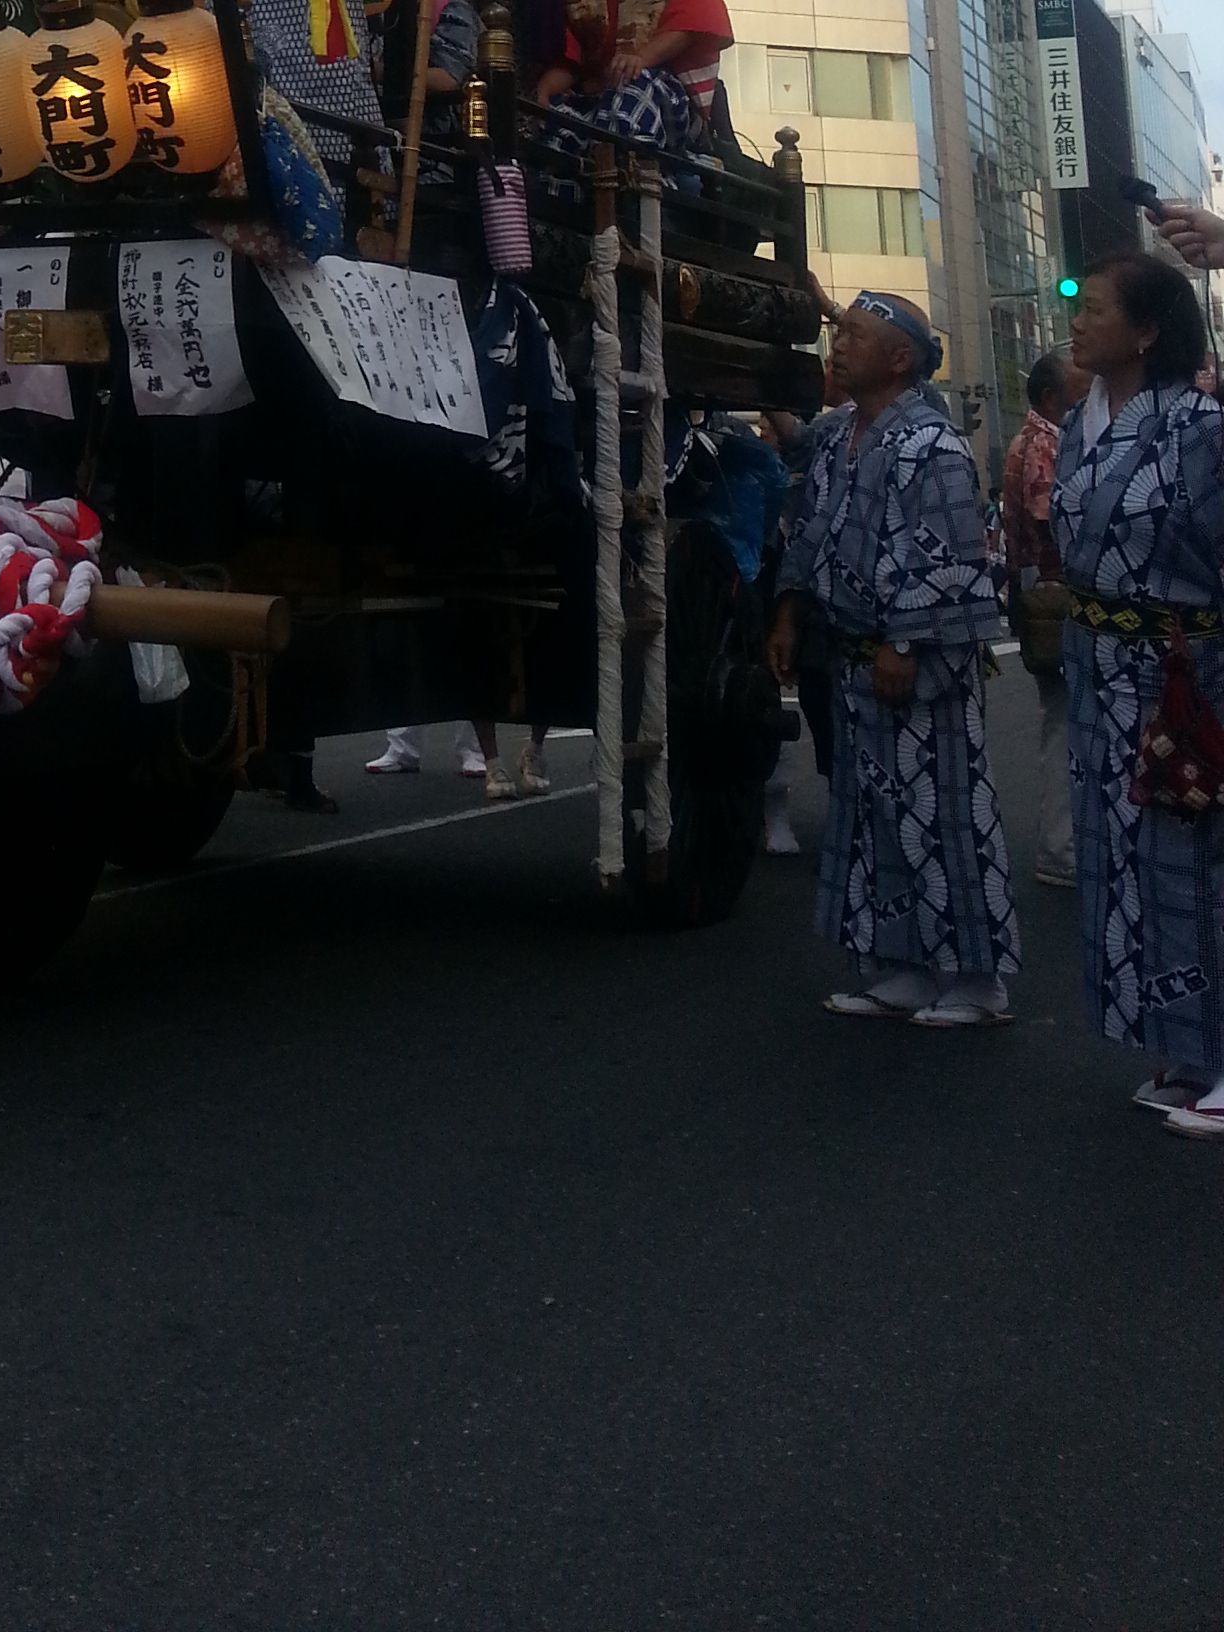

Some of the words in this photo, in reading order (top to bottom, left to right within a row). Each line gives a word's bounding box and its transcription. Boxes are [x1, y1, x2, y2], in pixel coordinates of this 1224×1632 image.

[31, 44, 116, 176] 大門町
[124, 32, 185, 167] 大門町
[1047, 48, 1078, 178] 三井住友銀行
[50, 258, 62, 285] のし
[213, 251, 225, 278] のし
[1137, 962, 1210, 1012] 大門町
